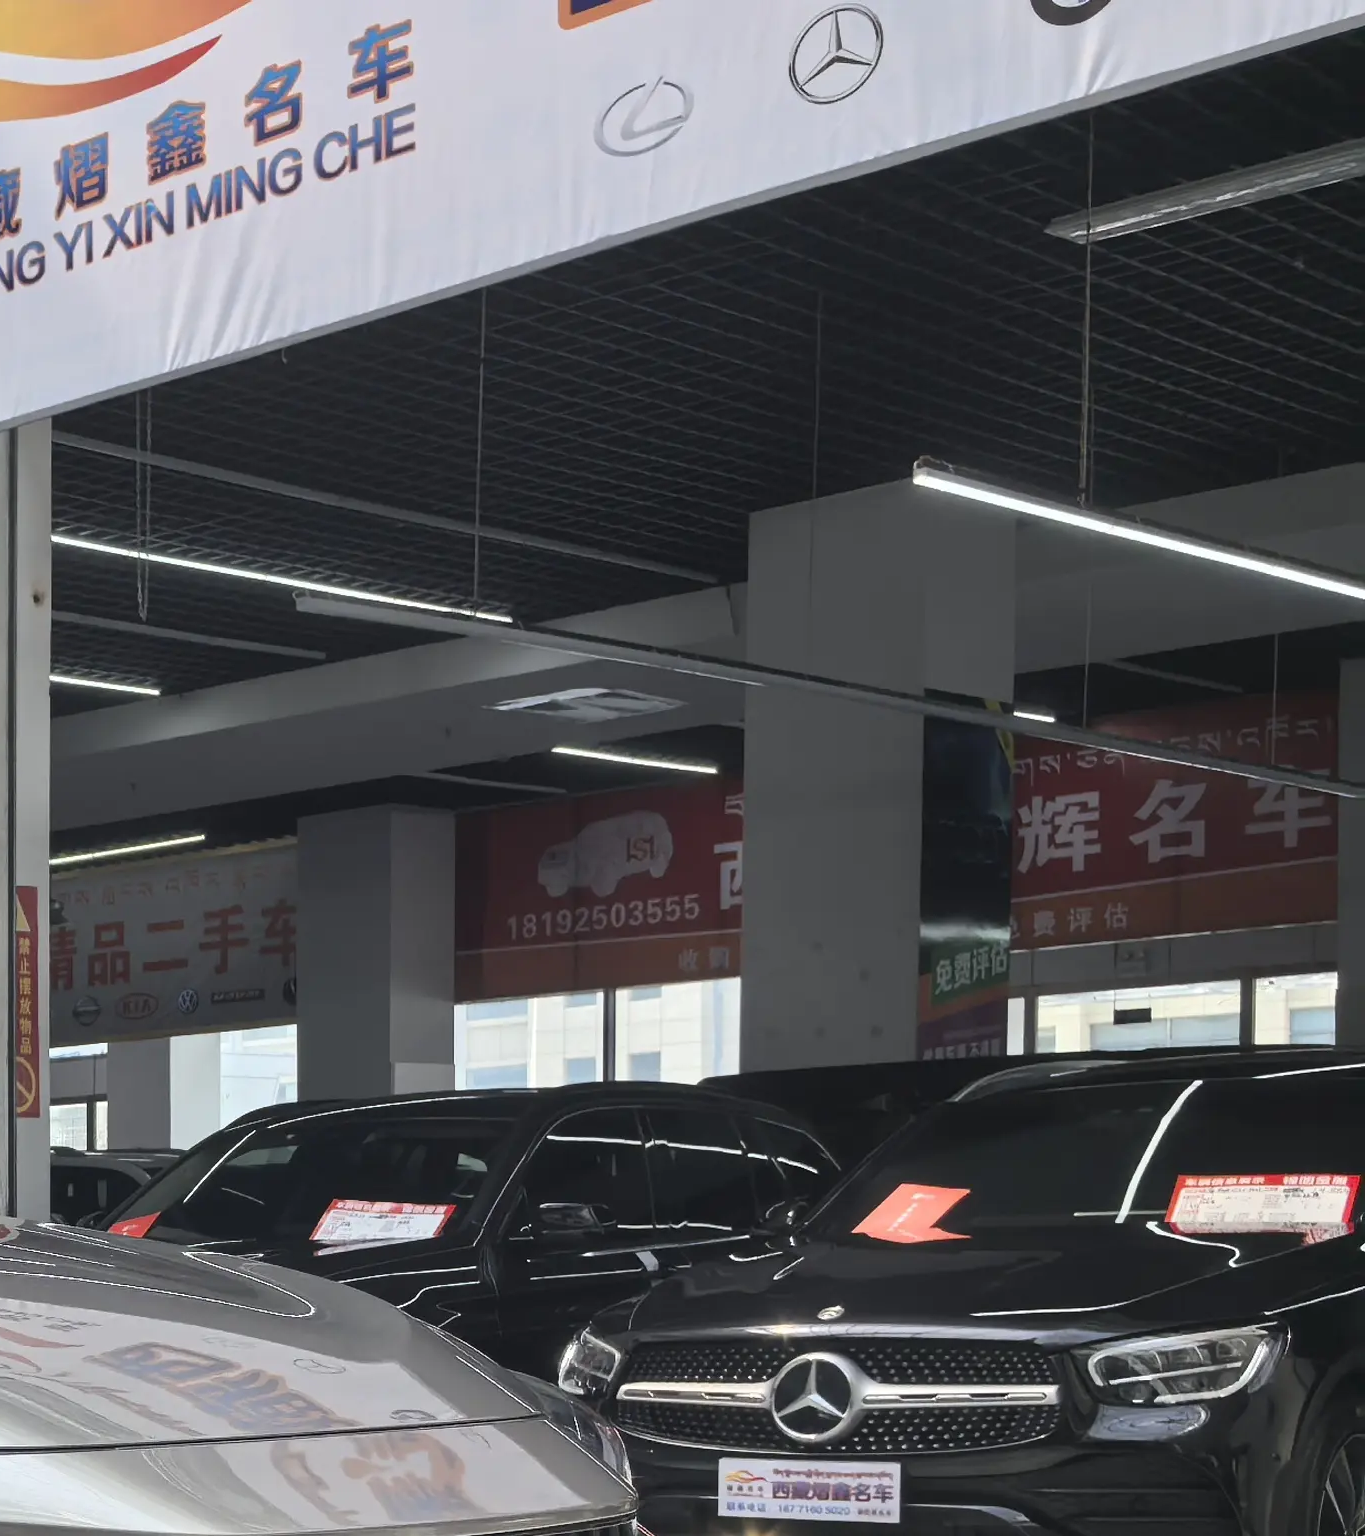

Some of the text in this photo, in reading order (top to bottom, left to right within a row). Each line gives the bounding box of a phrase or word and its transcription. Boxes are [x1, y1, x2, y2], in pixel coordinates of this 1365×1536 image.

[53, 219, 94, 272] YI
[102, 190, 176, 259] XIN
[185, 148, 303, 230] MING
[313, 103, 417, 182] CHE
[507, 894, 701, 941] 18192503555
[935, 942, 1008, 995] 免费评估
